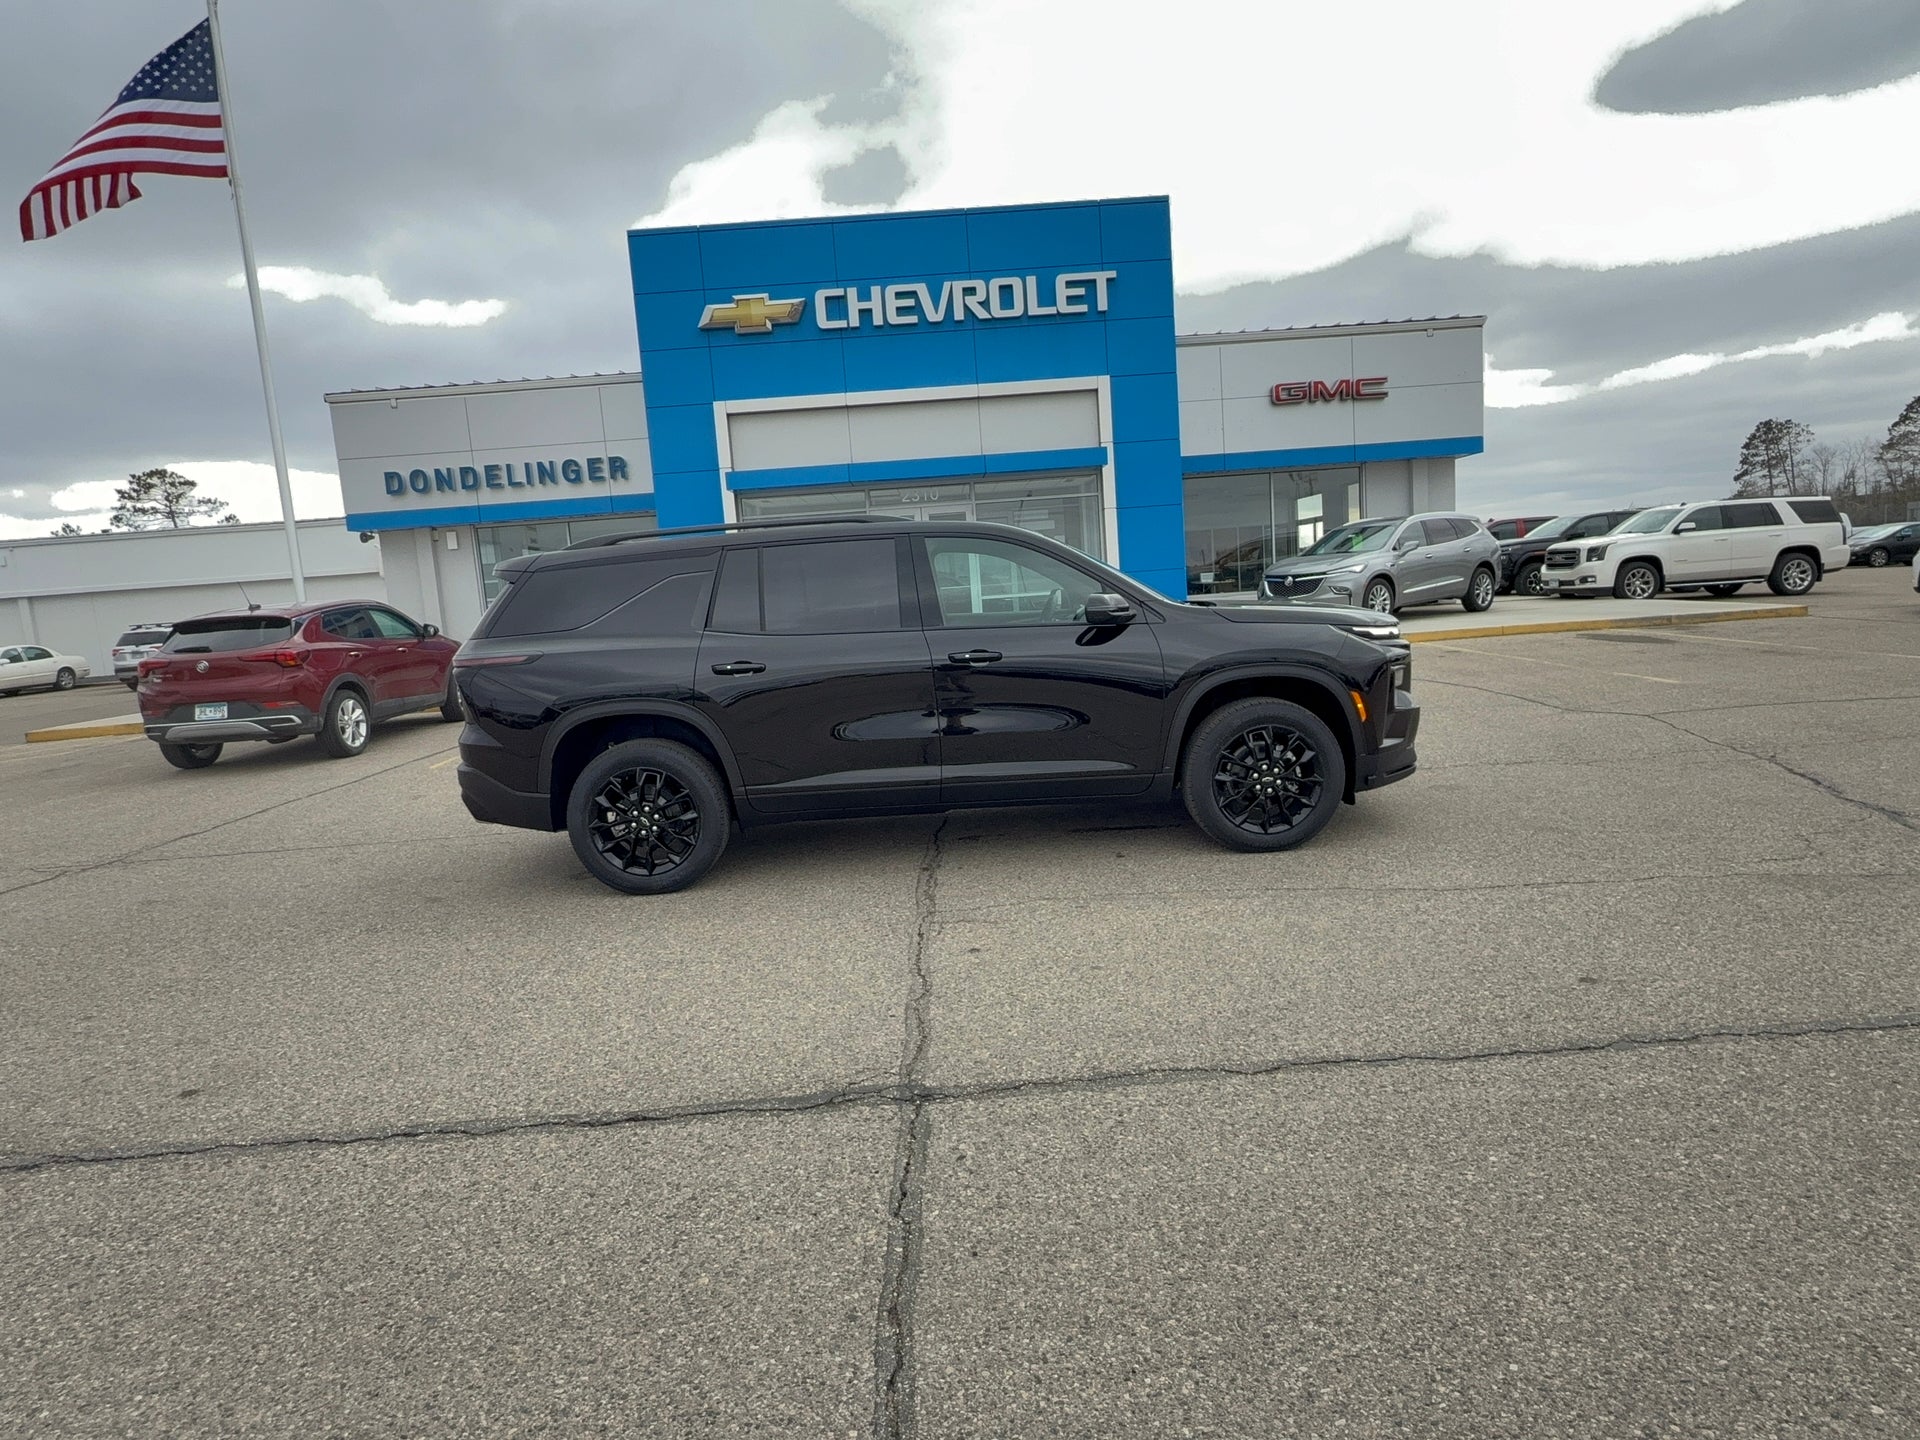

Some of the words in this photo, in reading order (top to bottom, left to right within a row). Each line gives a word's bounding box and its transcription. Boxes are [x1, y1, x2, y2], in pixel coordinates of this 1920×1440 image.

[814, 270, 1117, 330] CHEVROLET
[1271, 377, 1388, 405] GMC
[383, 455, 630, 496] DONDELINGER
